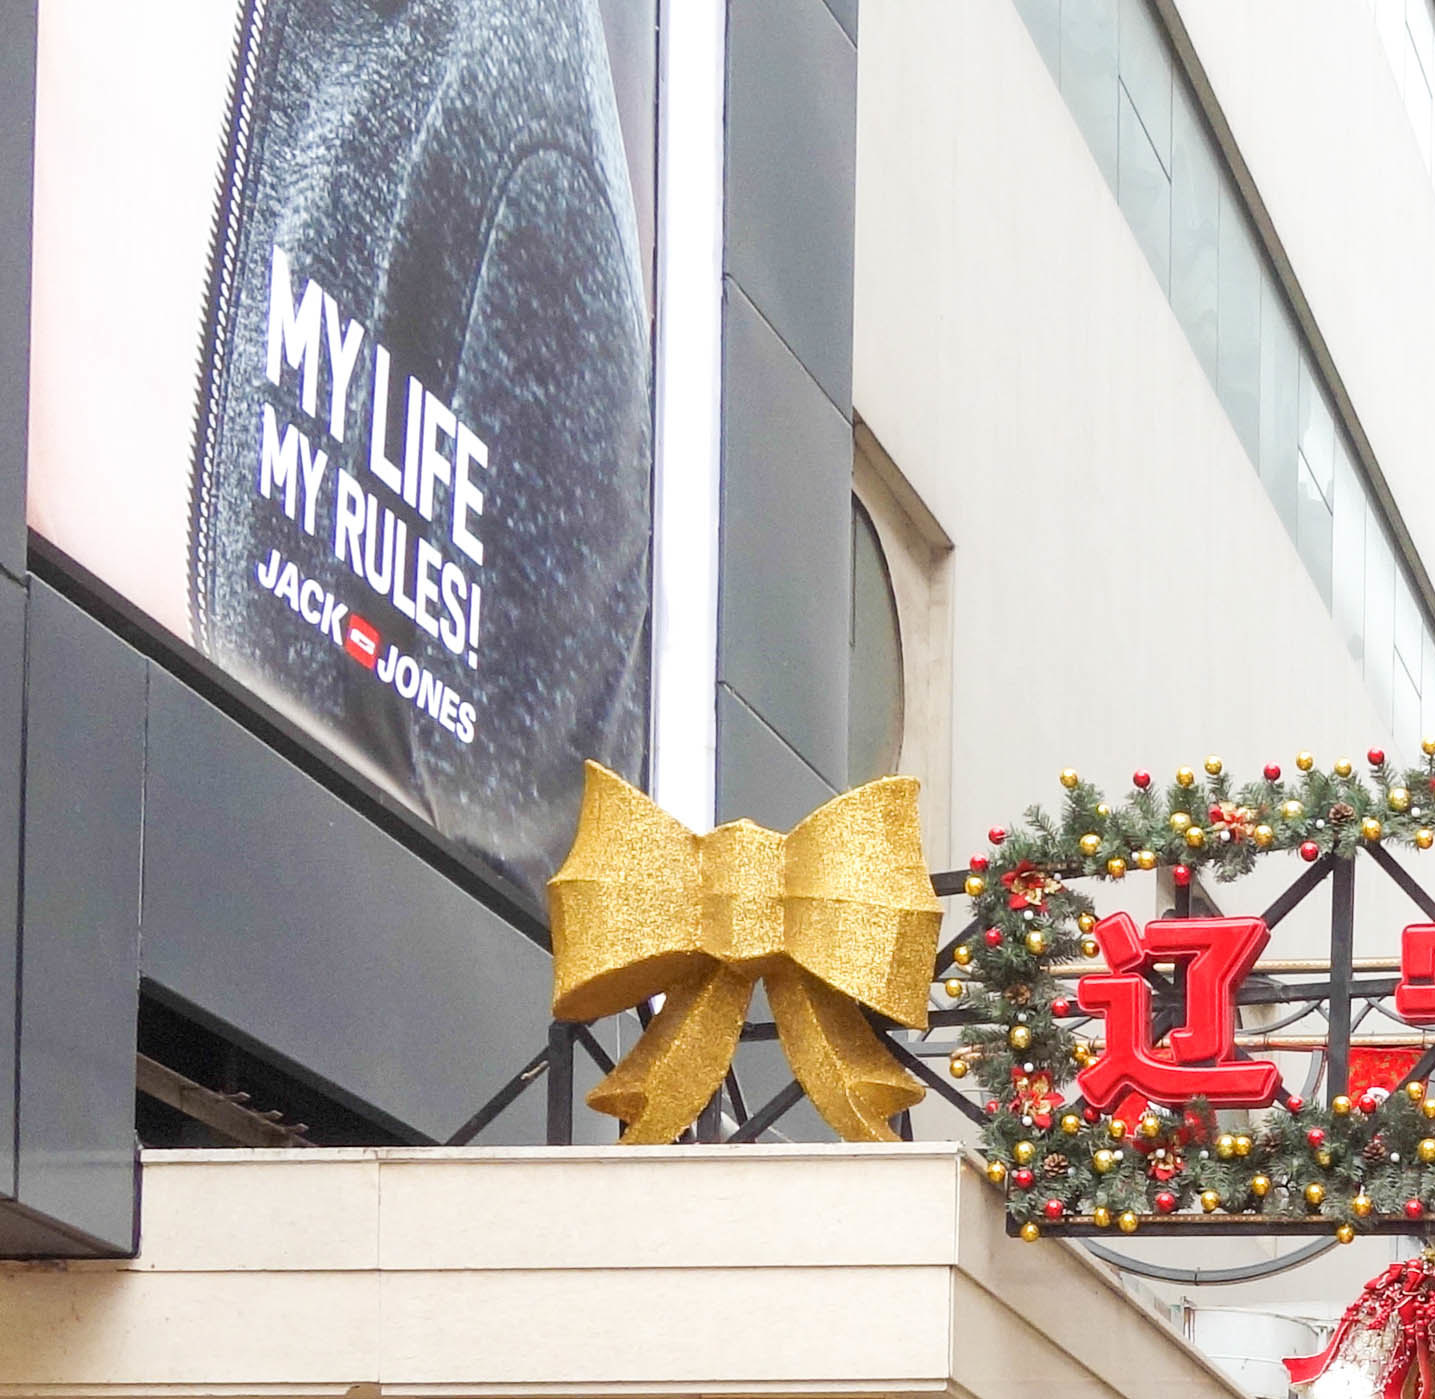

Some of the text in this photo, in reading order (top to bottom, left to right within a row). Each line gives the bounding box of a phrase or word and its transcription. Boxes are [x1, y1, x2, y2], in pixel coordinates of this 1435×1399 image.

[260, 402, 481, 671] MY RULES!
[266, 244, 488, 566] MY LIFE
[257, 549, 476, 745] JACK JONES
